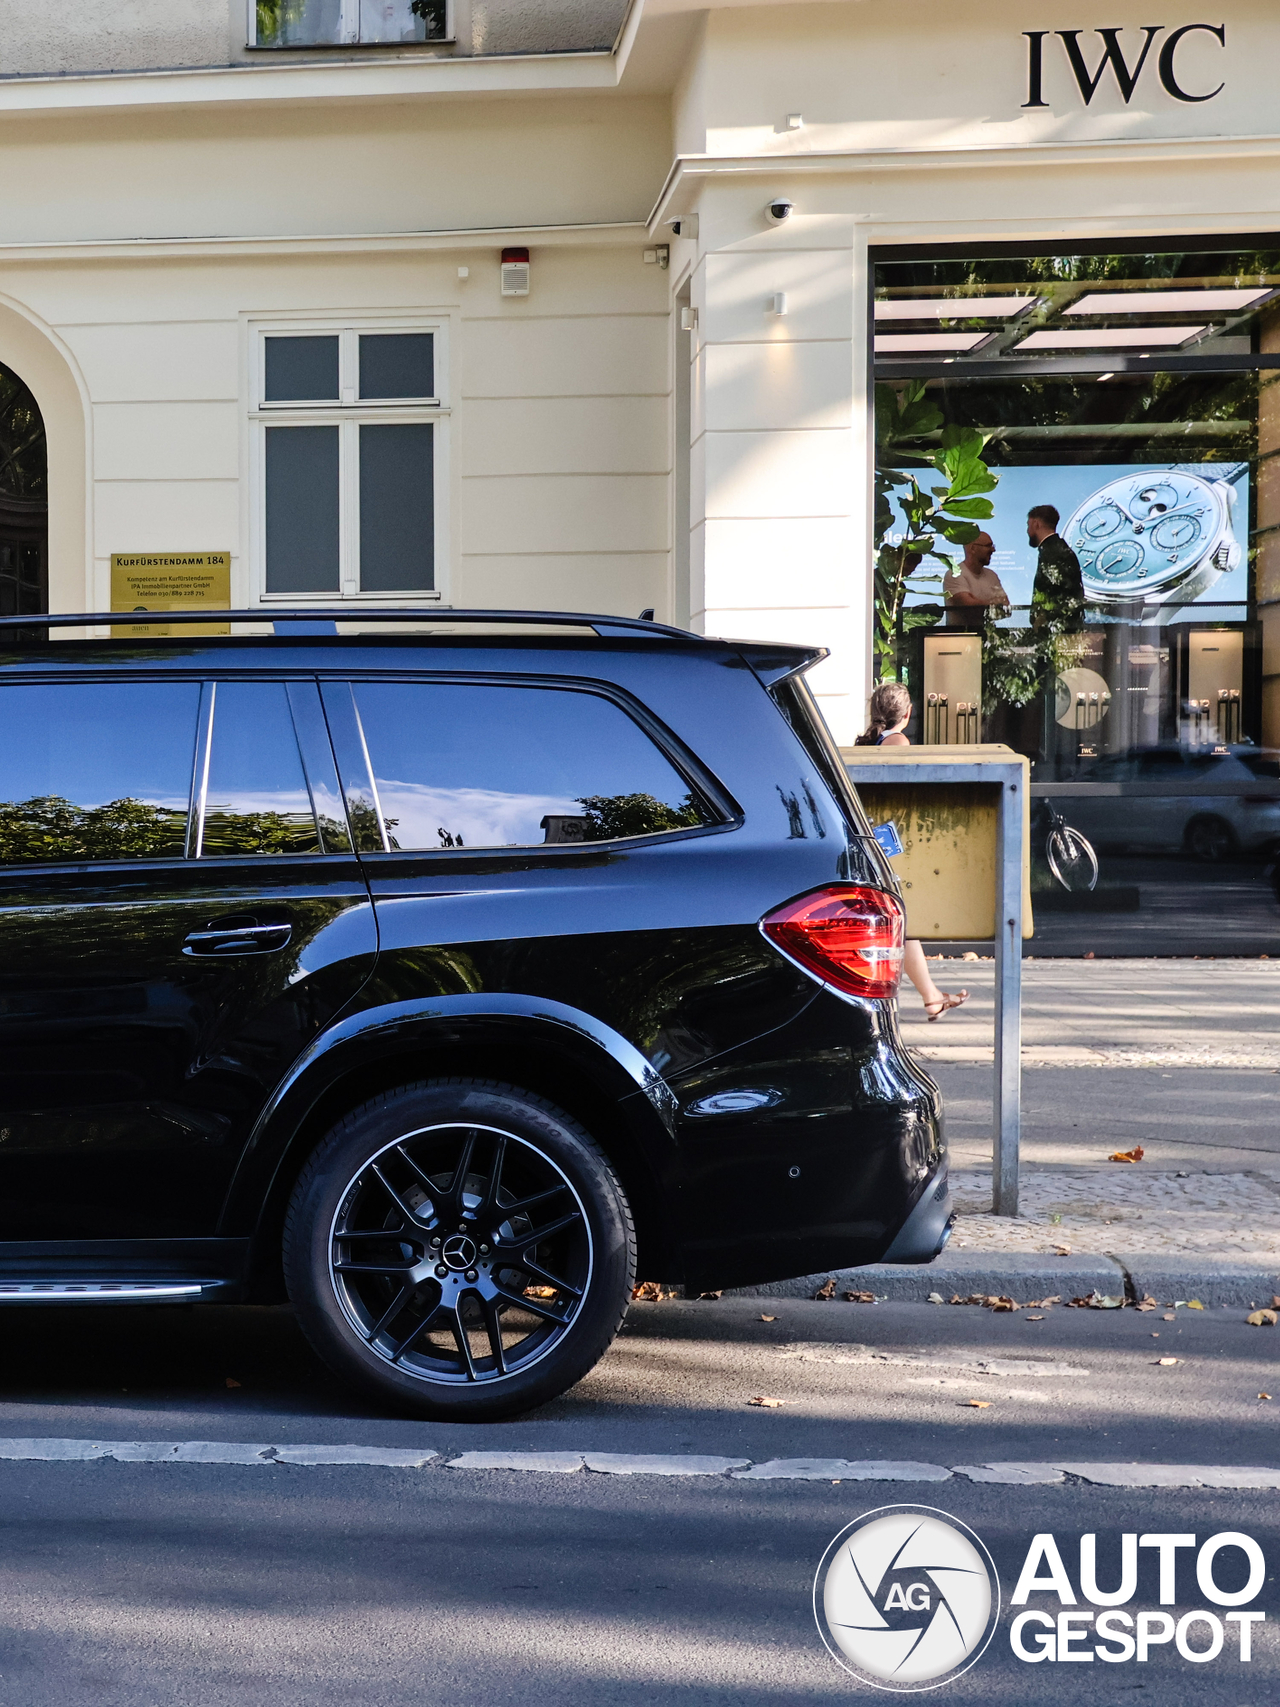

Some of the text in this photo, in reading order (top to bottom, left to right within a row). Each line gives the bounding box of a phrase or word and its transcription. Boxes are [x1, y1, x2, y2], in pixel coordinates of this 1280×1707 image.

[1021, 23, 1226, 108] IWC
[1075, 538, 1086, 548] 8
[116, 556, 224, 566] KURFÜRSTENDAMM 184
[1083, 558, 1093, 569] 7
[1167, 553, 1179, 564] 4
[1137, 567, 1148, 578] 5
